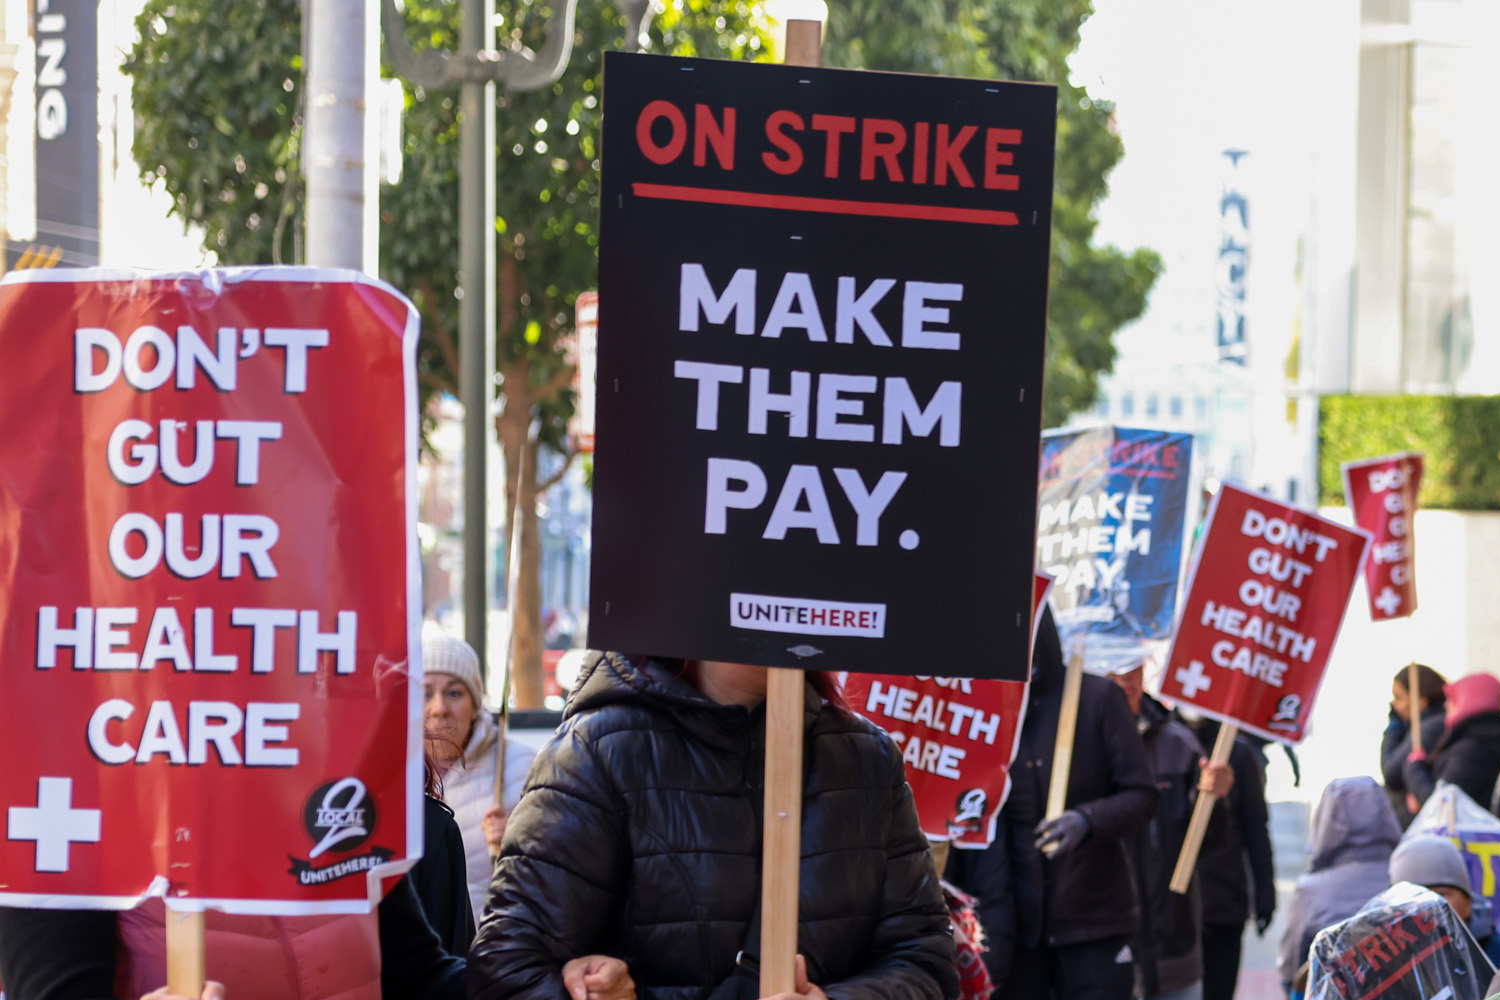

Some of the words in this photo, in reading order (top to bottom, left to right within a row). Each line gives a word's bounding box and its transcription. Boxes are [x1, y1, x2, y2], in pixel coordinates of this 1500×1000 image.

[636, 99, 737, 170] ON
[761, 110, 1023, 191] STRIKE
[679, 263, 964, 351] MAKE
[74, 326, 330, 394] DON'T
[674, 360, 962, 447] THEM
[107, 419, 283, 486] GUT
[704, 457, 920, 551] PAY.
[1039, 492, 1153, 531] MAKE
[1241, 508, 1338, 562] DON'T
[108, 511, 279, 579] OUR
[1037, 525, 1151, 562] THEM
[1248, 547, 1312, 588] GUT
[1200, 600, 1317, 663] HEALTH
[1239, 579, 1302, 622] OUR
[36, 606, 357, 675] HEALTH
[1211, 640, 1289, 688] CARE
[87, 698, 300, 766] CARE
[866, 680, 1000, 745] HEALTH
[316, 808, 364, 826] LOCAL
